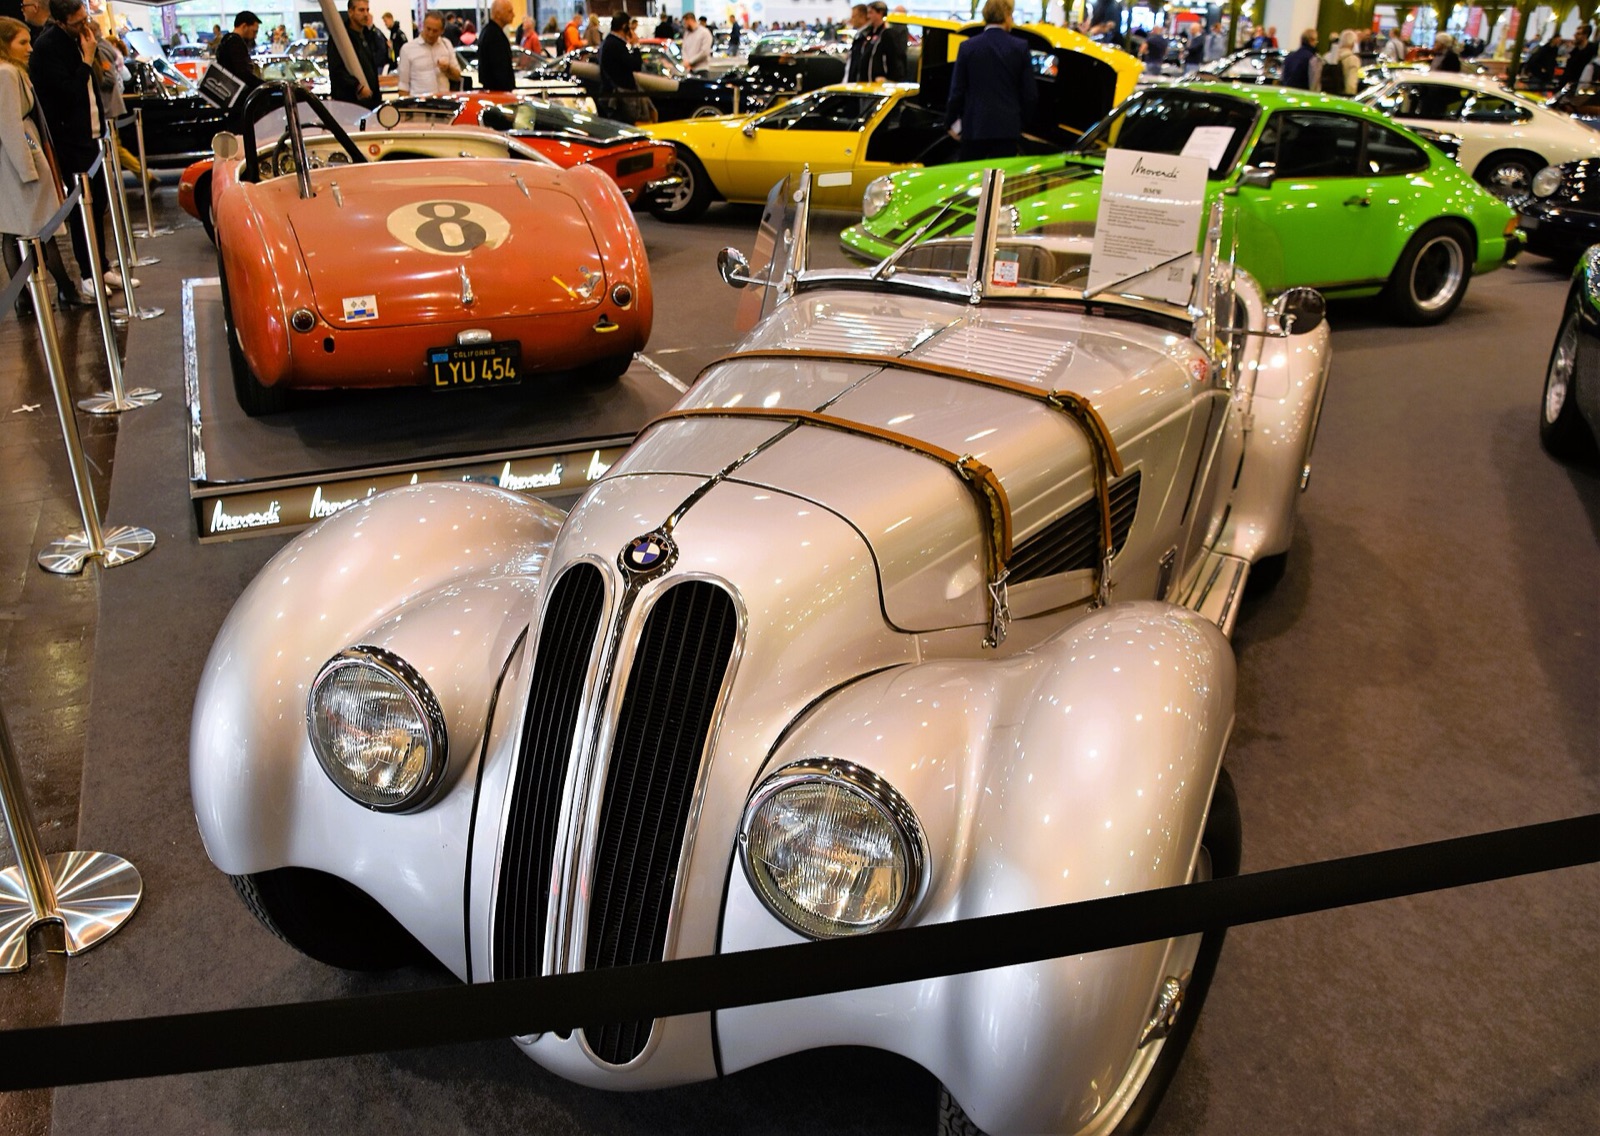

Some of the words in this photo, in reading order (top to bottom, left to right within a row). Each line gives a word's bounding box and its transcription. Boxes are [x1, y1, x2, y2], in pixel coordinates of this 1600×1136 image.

[415, 202, 487, 253] 8
[453, 348, 496, 359] CALIFORNIA
[434, 360, 476, 387] LYU
[481, 357, 516, 381] 454
[632, 533, 669, 551] BMW
